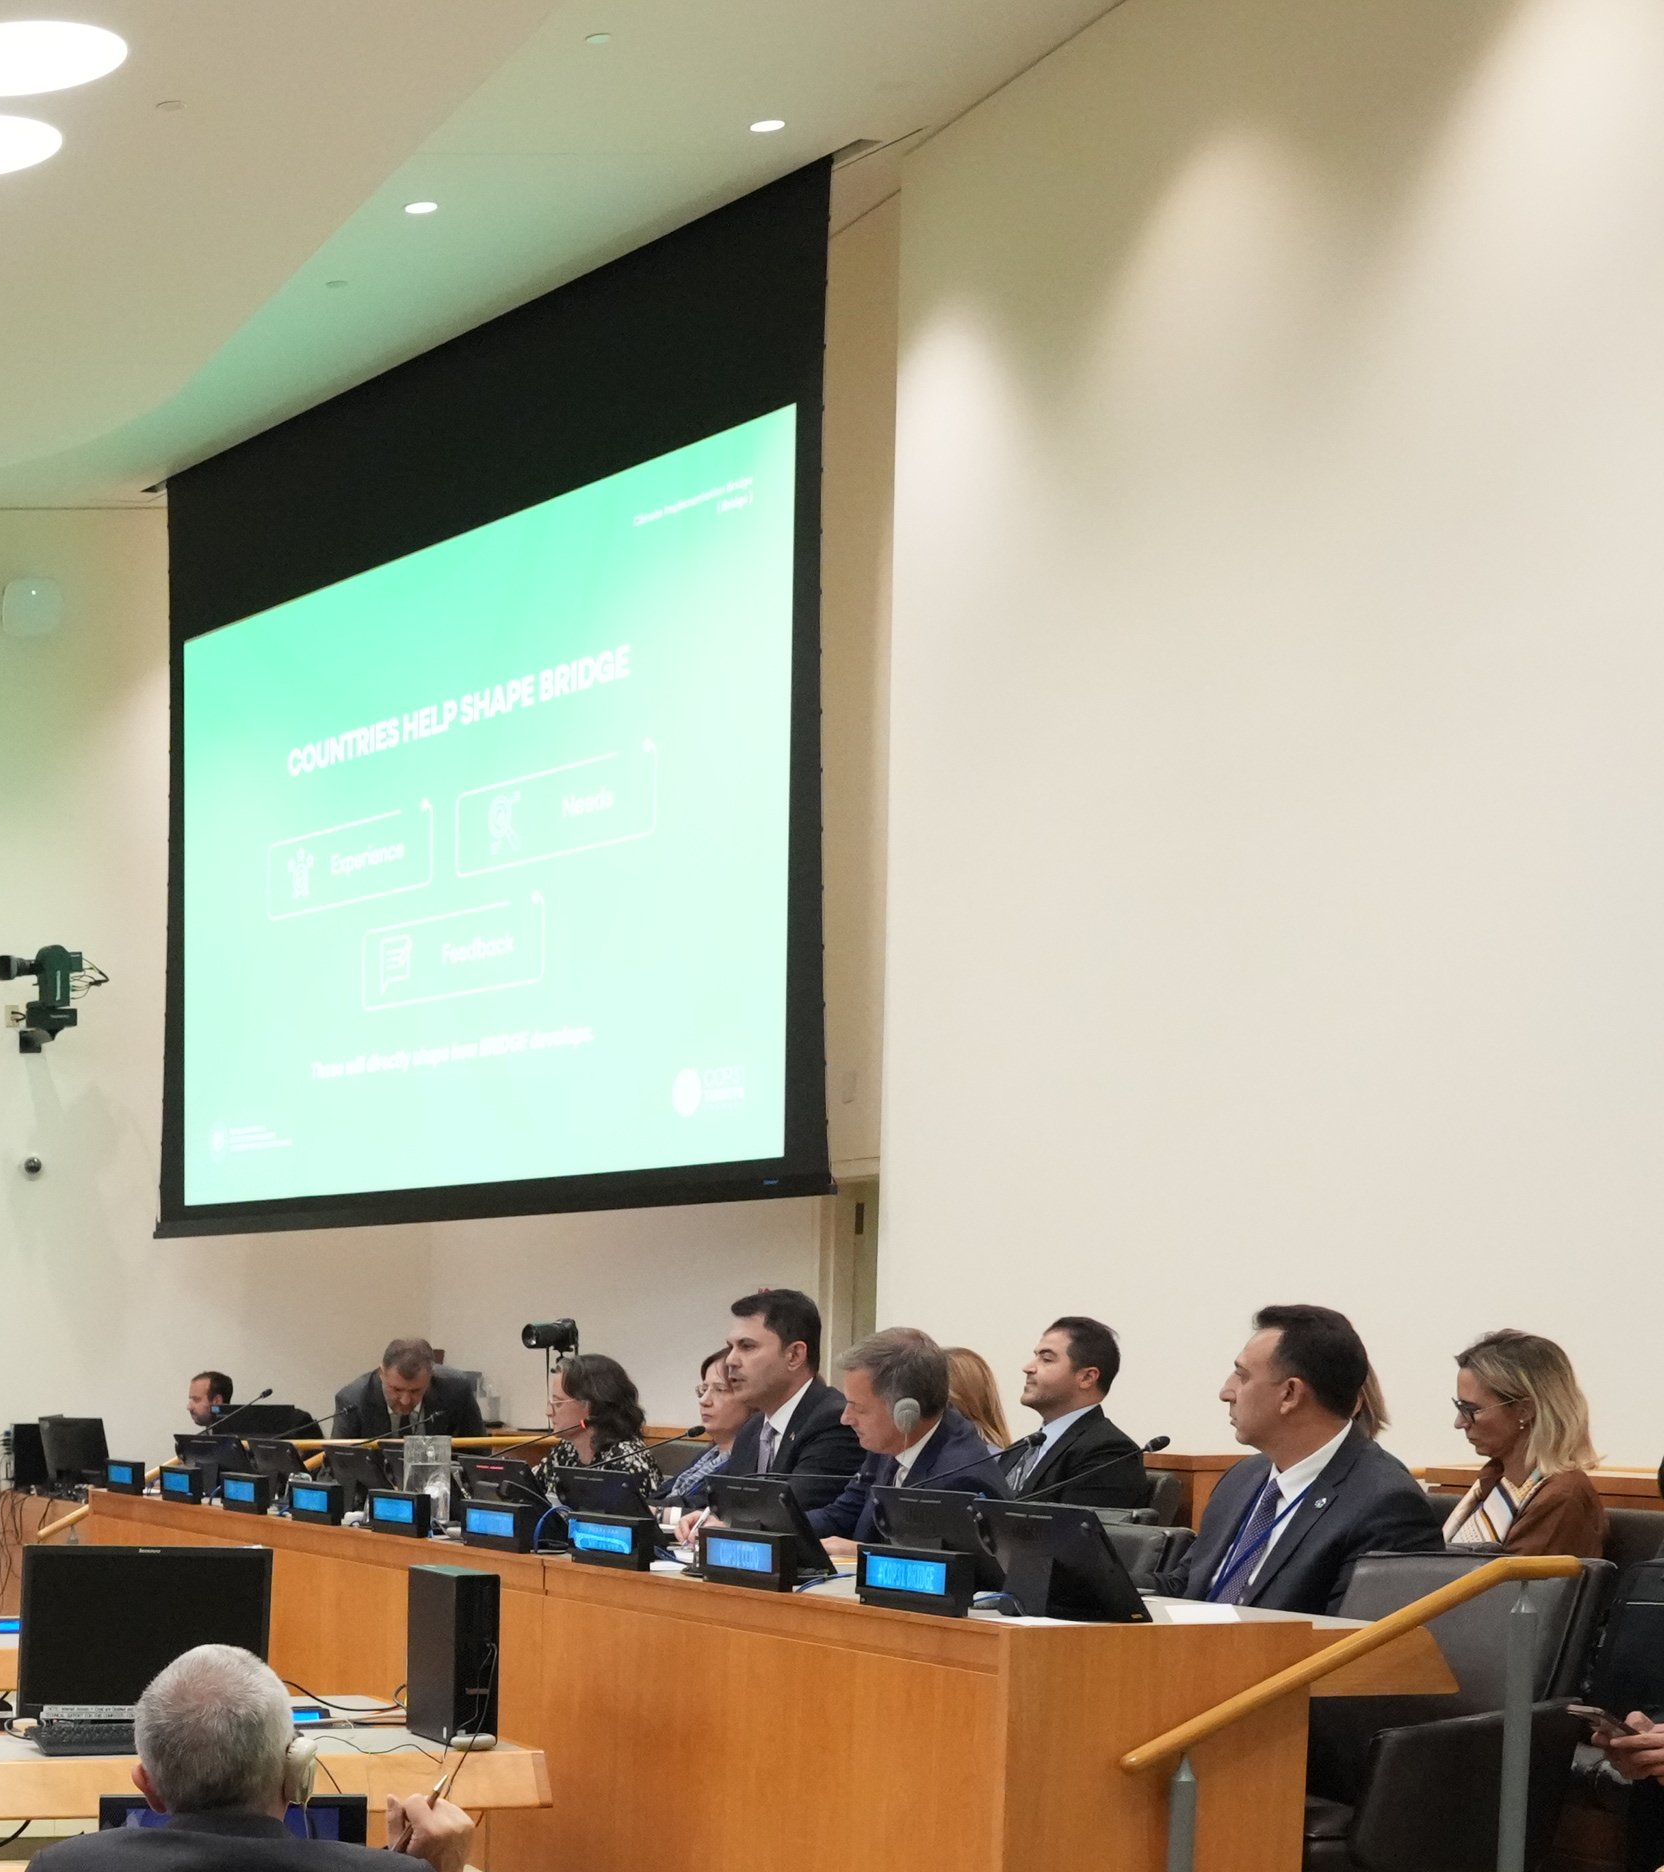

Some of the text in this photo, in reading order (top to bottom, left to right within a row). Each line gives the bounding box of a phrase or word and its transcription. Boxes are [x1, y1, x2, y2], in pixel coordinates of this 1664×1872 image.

[288, 645, 630, 776] COUNTRIES HELP SHAPE BRIDGE
[330, 842, 405, 876] Experience
[442, 932, 514, 966] Feedback
[907, 1563, 934, 1591] BRIDGE
